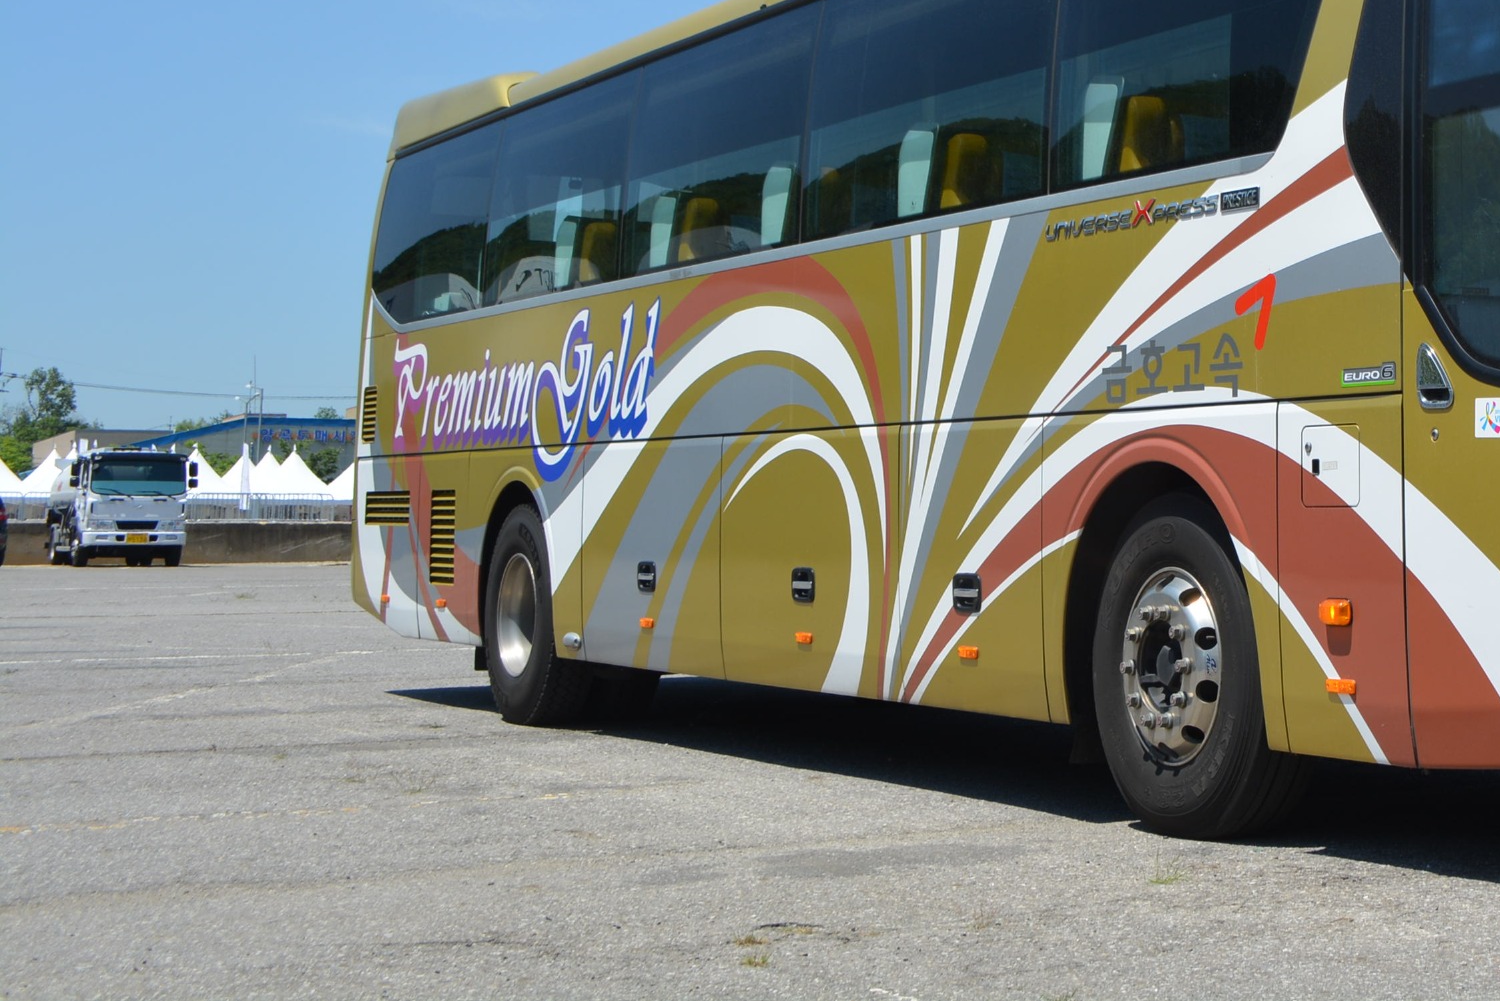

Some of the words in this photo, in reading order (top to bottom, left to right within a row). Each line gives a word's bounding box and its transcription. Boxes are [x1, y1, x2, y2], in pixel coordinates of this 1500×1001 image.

[394, 338, 535, 449] Premium
[531, 296, 660, 481] Gold
[1102, 333, 1243, 404] 금호고속
